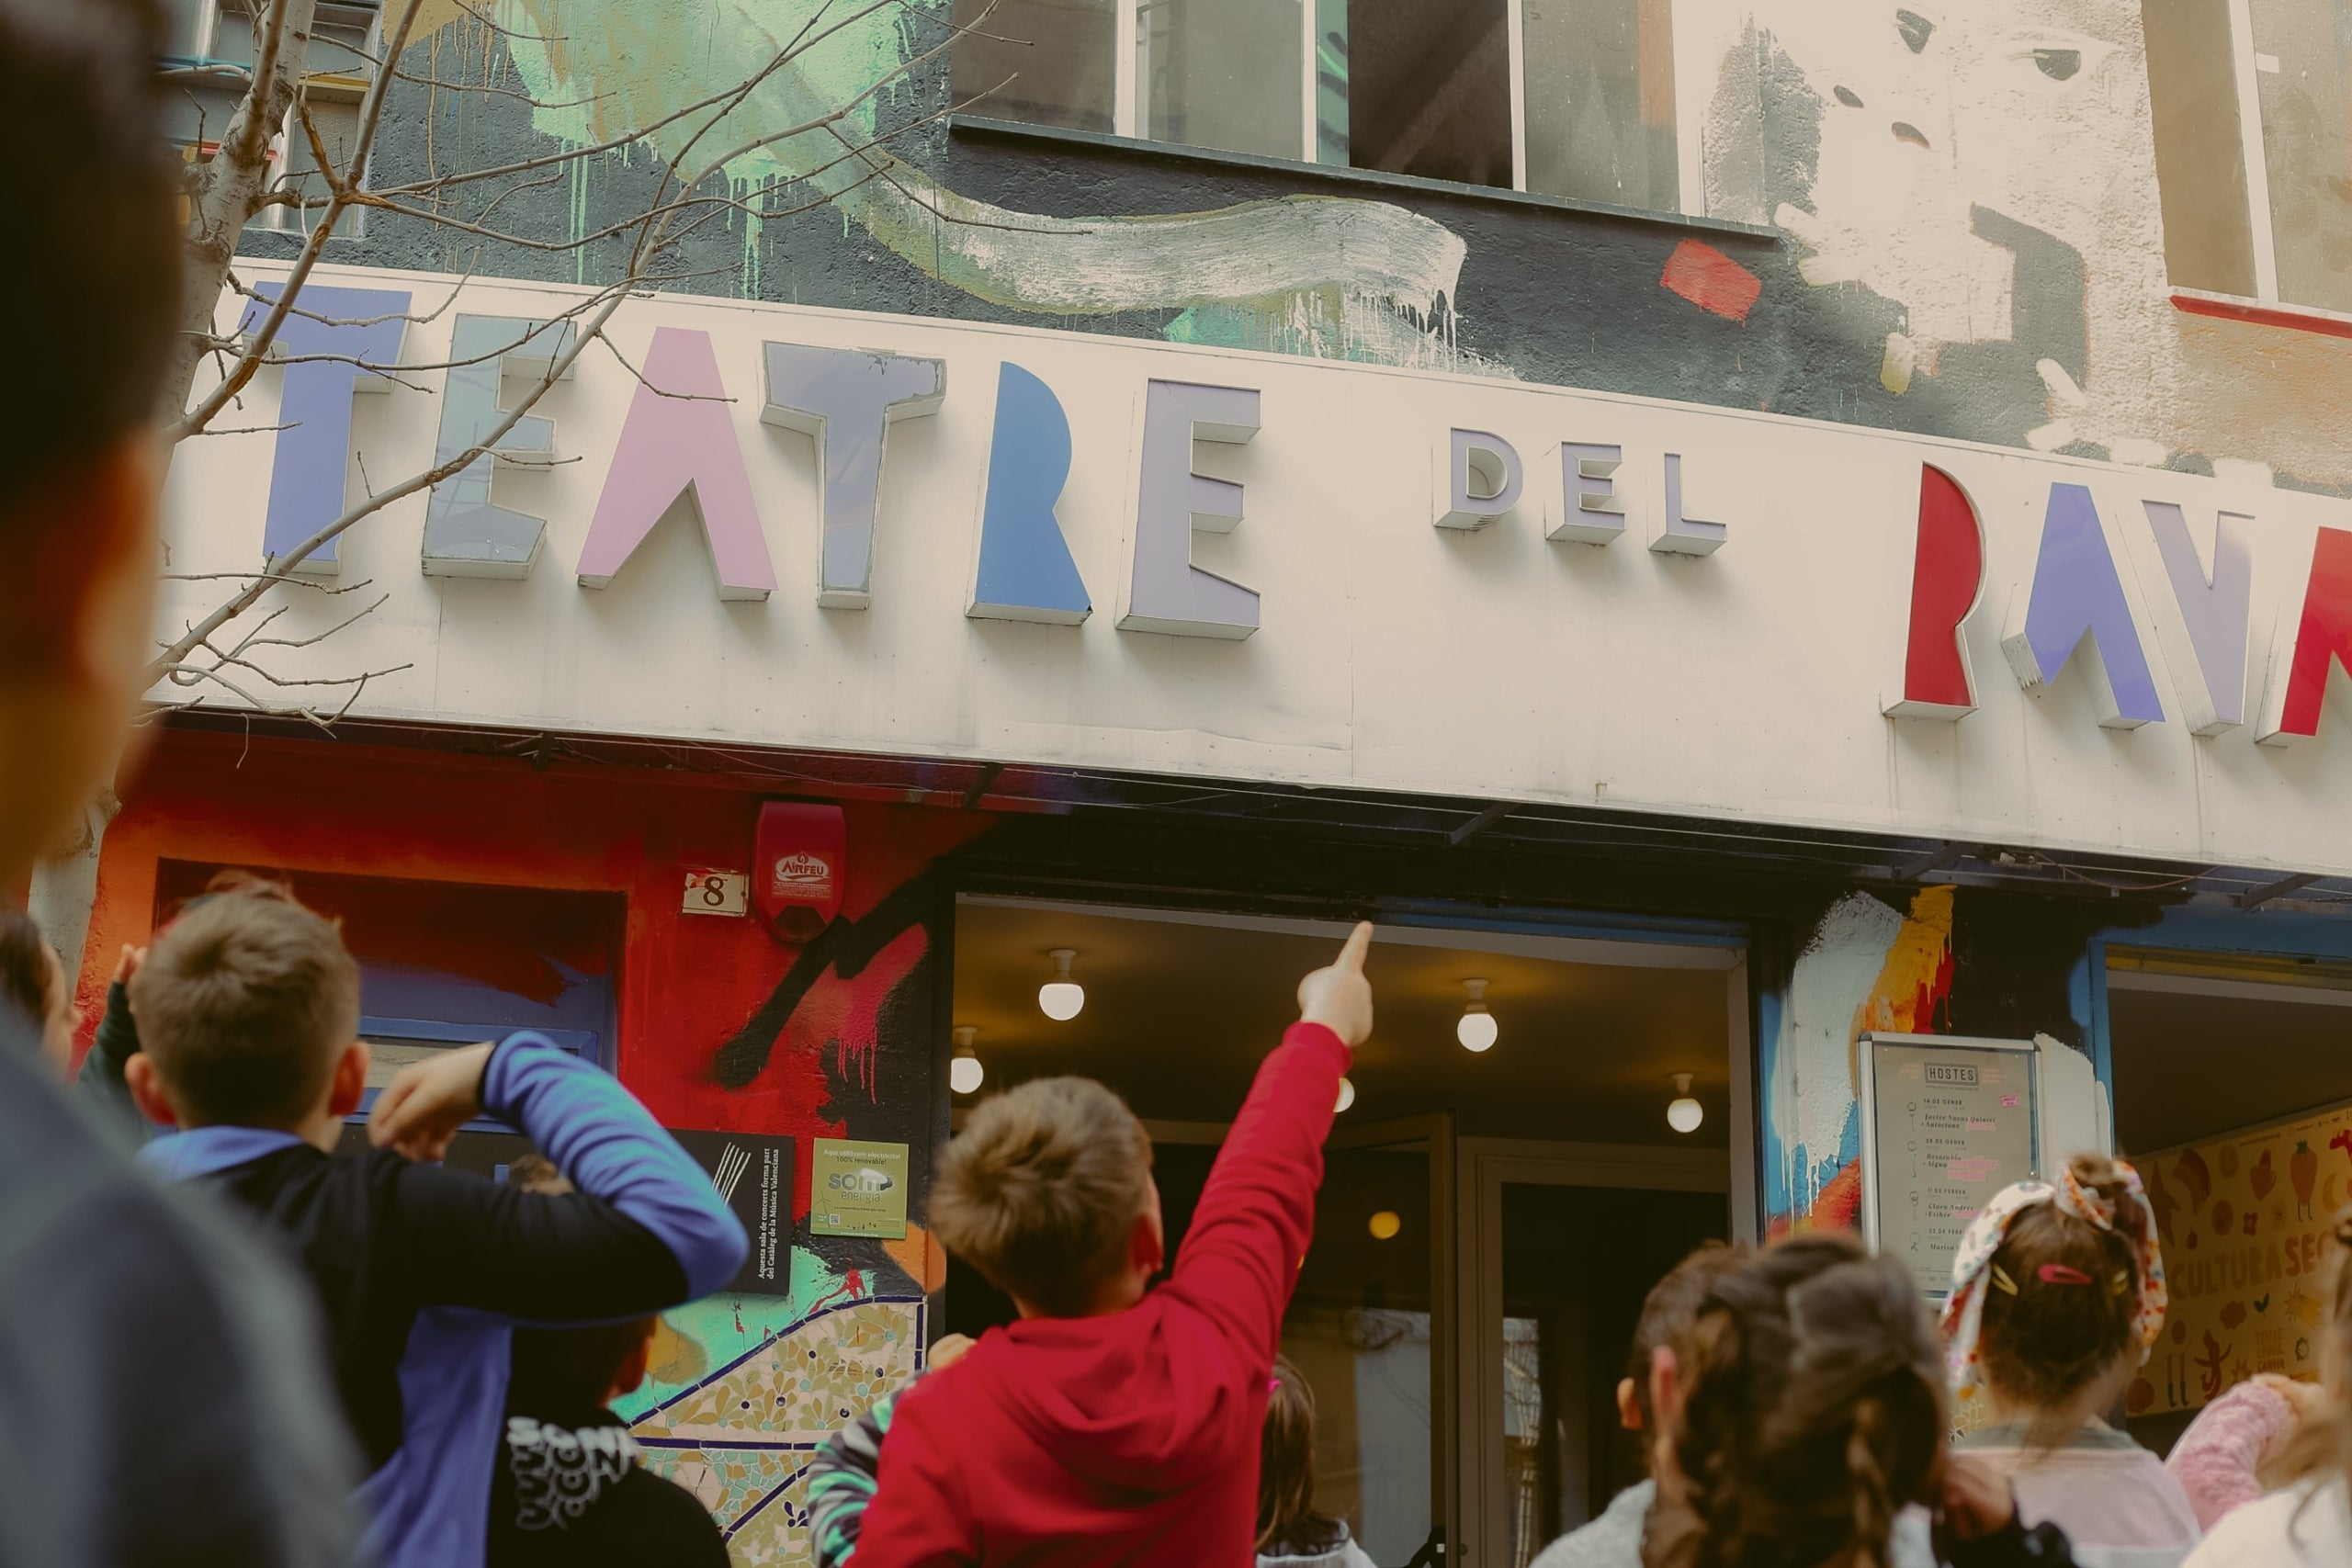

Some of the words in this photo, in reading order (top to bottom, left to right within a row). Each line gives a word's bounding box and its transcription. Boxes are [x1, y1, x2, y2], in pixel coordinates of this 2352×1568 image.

[239, 280, 1261, 640] TEATRE
[1434, 427, 1727, 556] DEL
[704, 876, 725, 907] 8
[1929, 1067, 1974, 1081] HOSTES
[763, 1148, 772, 1164] part
[854, 1157, 888, 1166] renovable!
[867, 1152, 901, 1160] electricitat
[761, 1165, 770, 1189] forma
[770, 1148, 779, 1190] Valenciana
[769, 1190, 777, 1218] Música
[841, 1190, 880, 1204] energia
[760, 1222, 768, 1231] de
[768, 1227, 776, 1237] de
[767, 1237, 777, 1267] Catàleg
[758, 1248, 766, 1280] Aquesta
[766, 1267, 775, 1280] del
[2169, 1242, 2282, 1300] CULTURA
